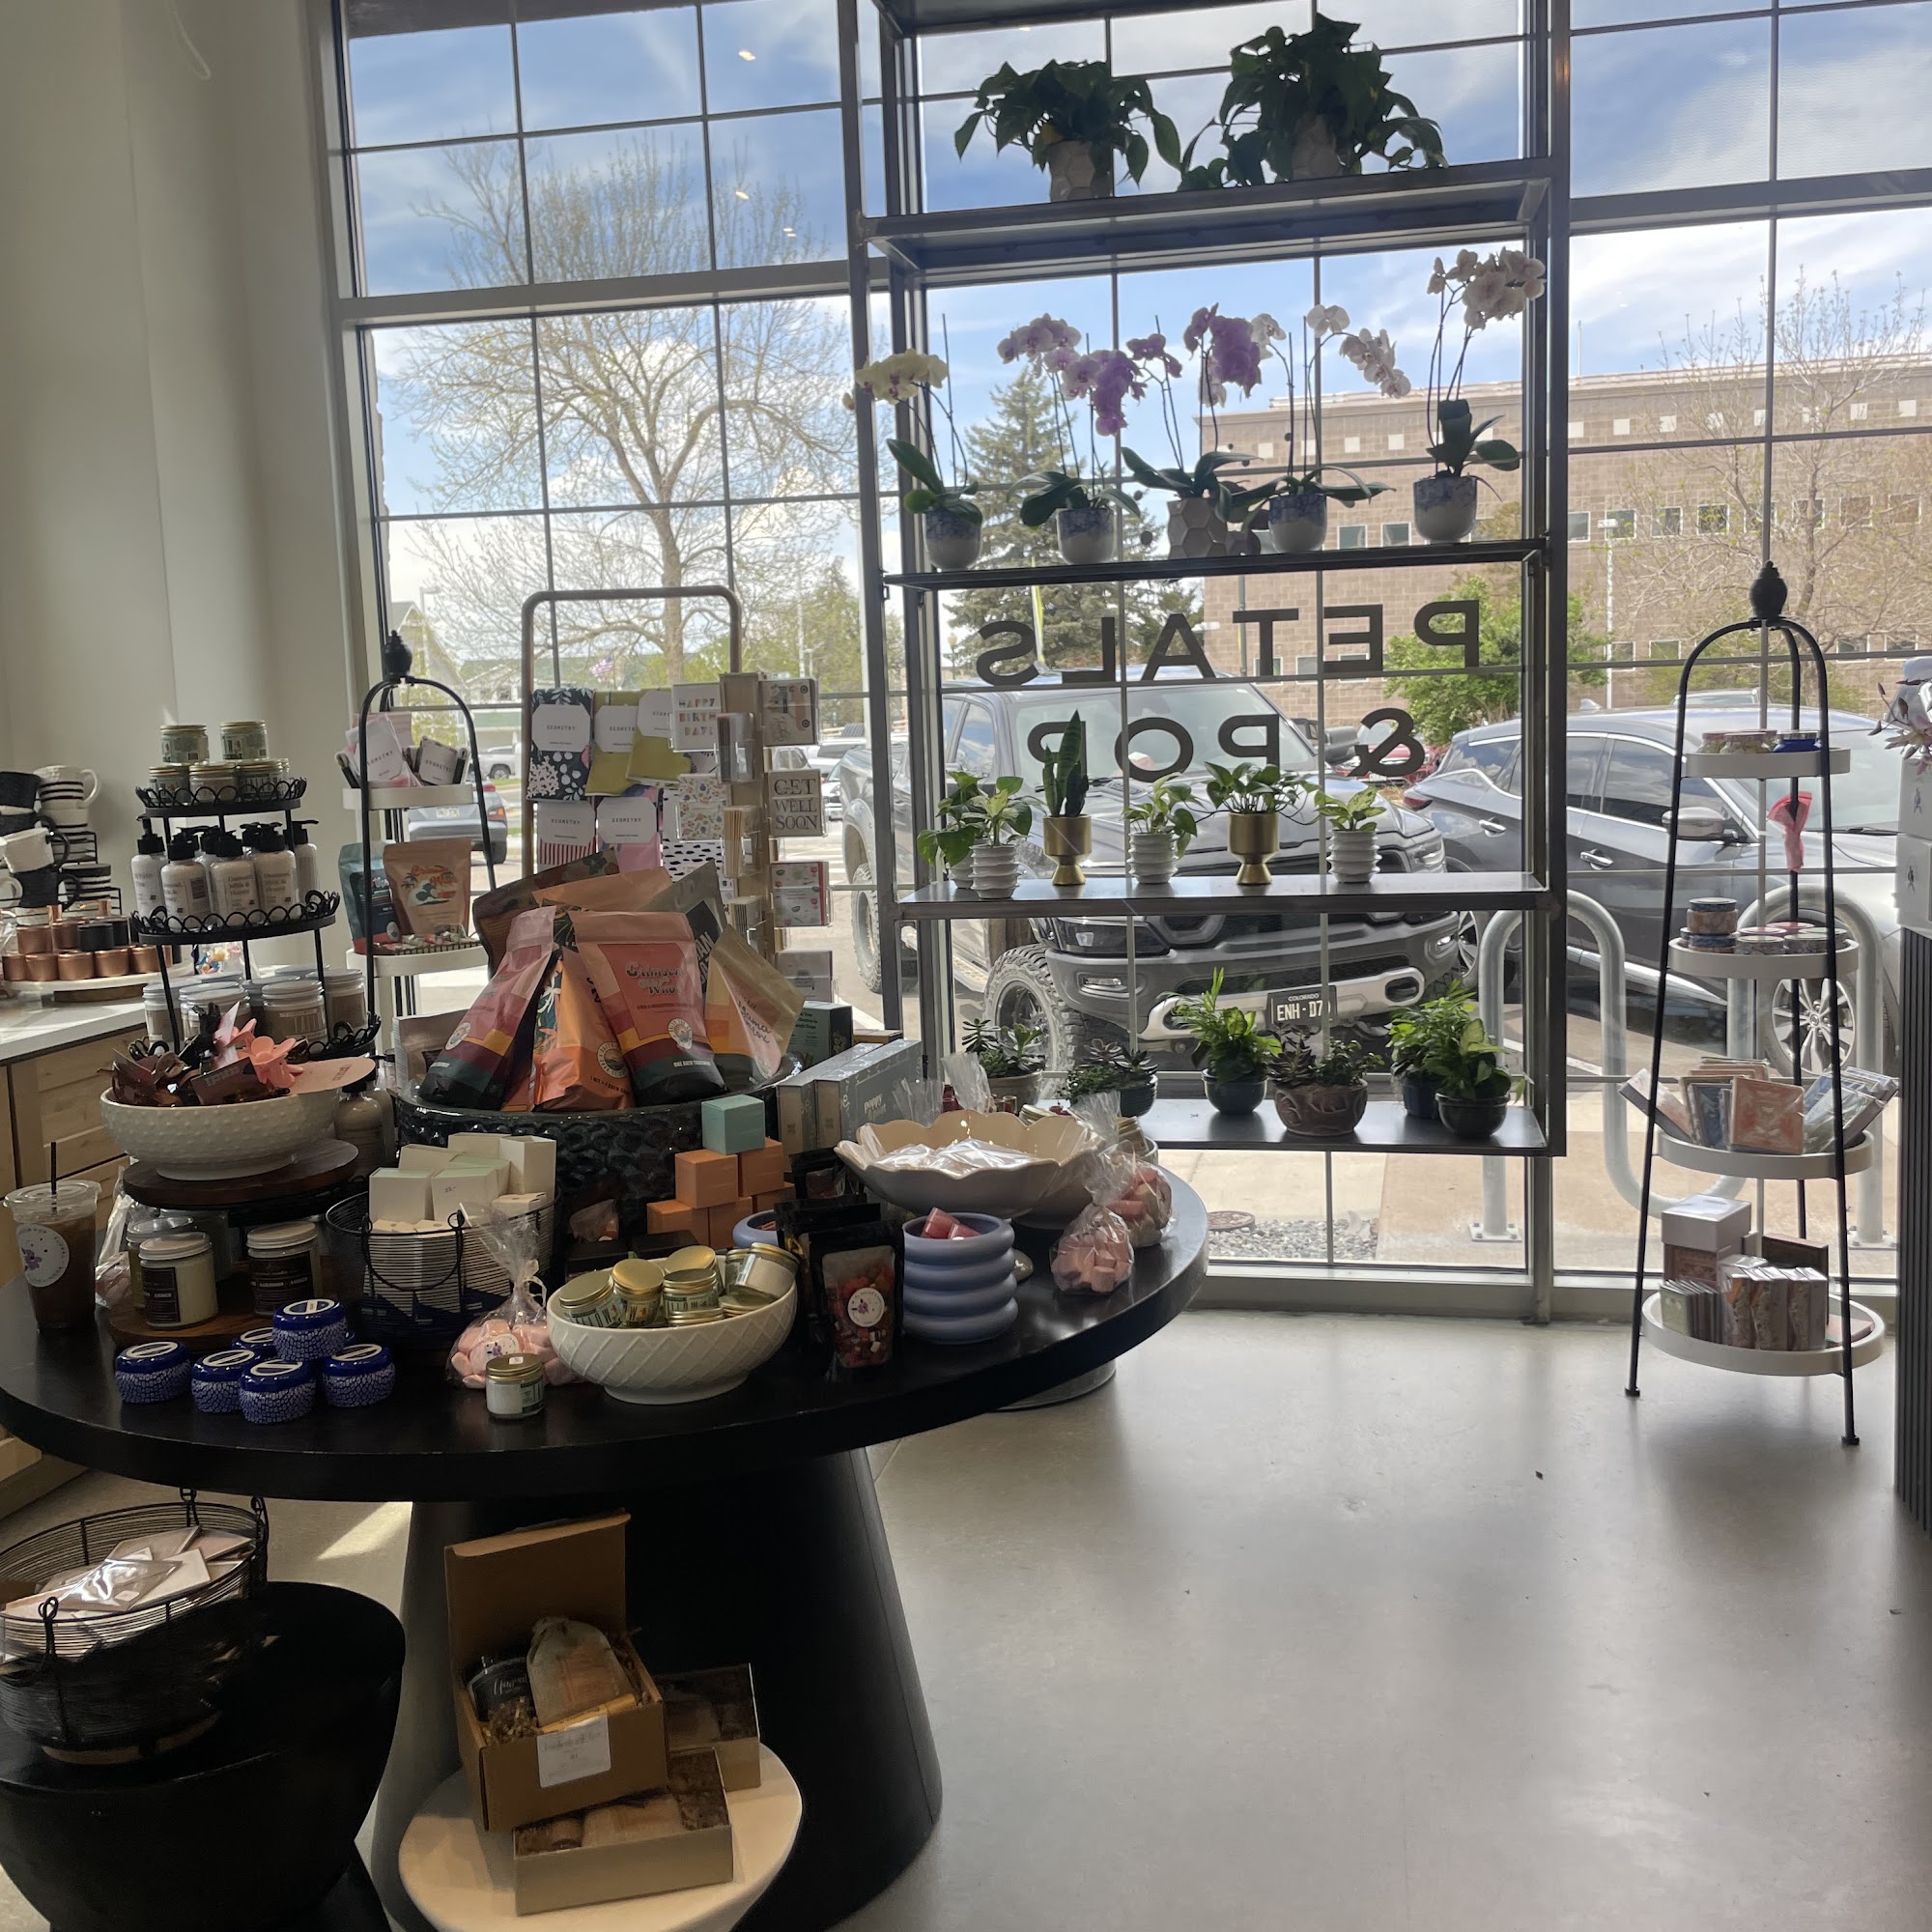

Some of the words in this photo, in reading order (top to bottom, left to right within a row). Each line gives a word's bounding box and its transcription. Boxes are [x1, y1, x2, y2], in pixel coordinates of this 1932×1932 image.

[678, 698, 716, 708] HAPPY
[679, 712, 717, 723] BIRTH
[774, 779, 817, 795] GET
[775, 798, 817, 812] WELL
[776, 815, 818, 831] SOON
[1288, 993, 1320, 1002] COLORADO
